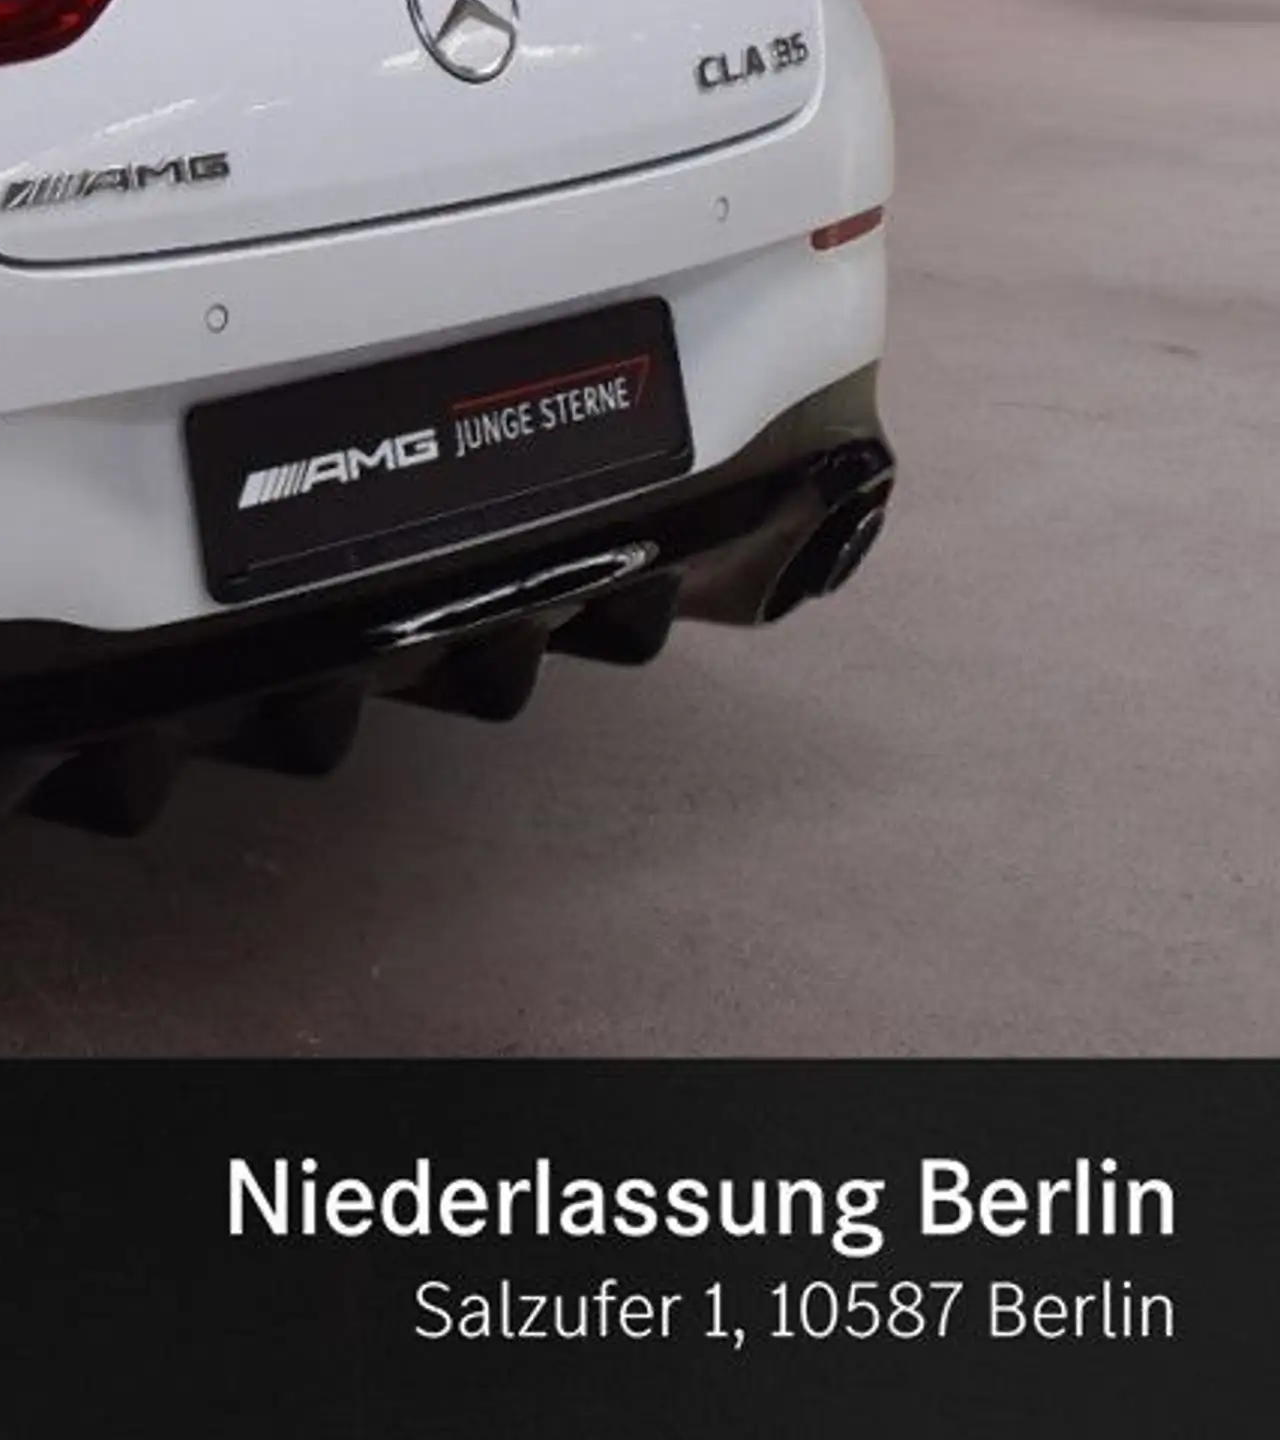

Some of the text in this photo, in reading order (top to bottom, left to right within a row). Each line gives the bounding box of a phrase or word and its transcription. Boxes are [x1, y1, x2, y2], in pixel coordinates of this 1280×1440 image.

[695, 45, 766, 92] CLA
[75, 152, 231, 198] AMG
[301, 376, 630, 494] AMG JUNGE STERNE
